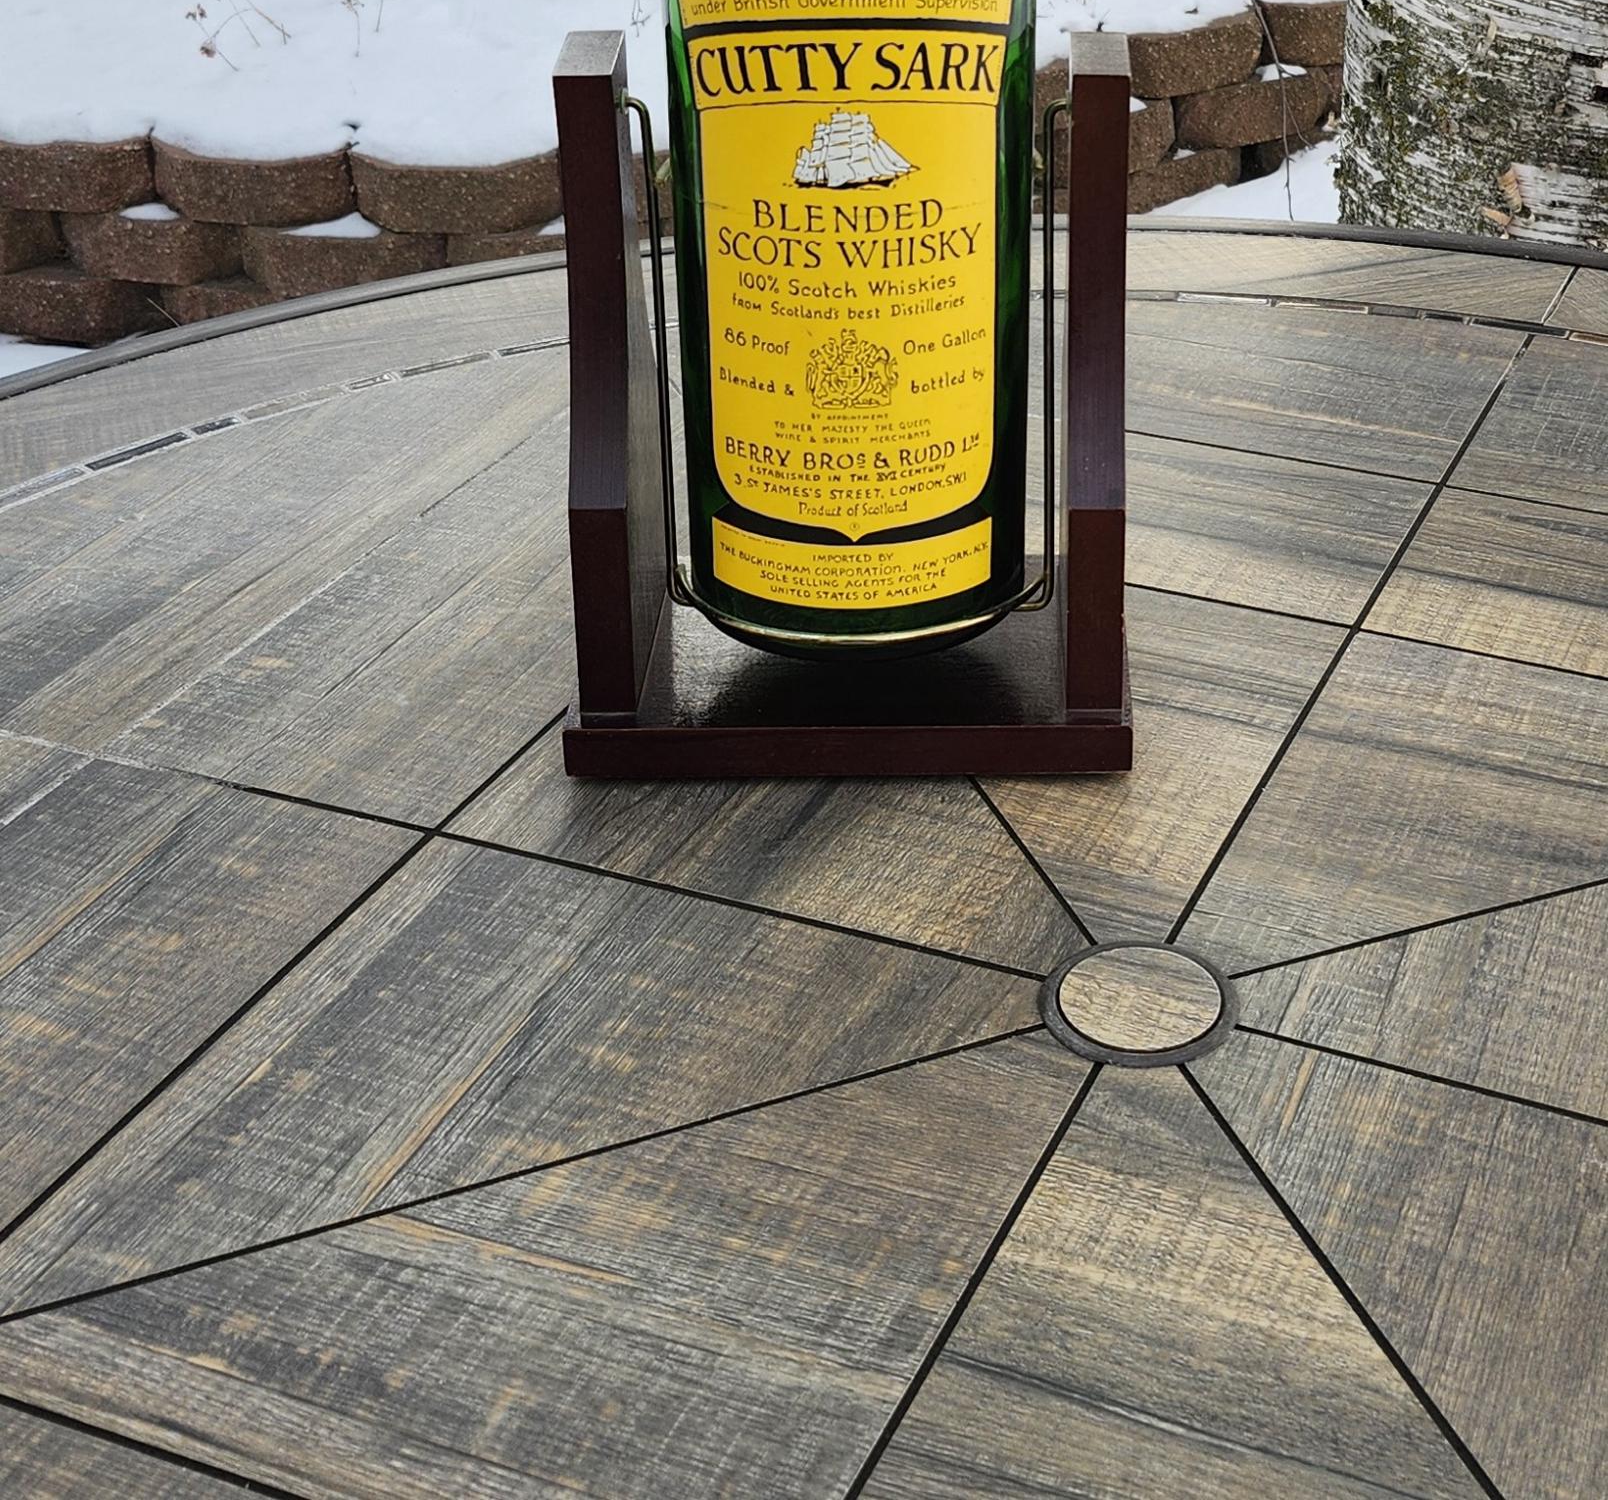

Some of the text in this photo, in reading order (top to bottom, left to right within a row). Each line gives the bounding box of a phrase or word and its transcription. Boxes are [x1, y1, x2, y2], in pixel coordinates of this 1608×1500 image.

[695, 41, 999, 97] CUTTY SARK
[752, 198, 944, 233] BLENDED
[718, 222, 982, 268] SCOTS WHISKY
[738, 271, 957, 299] 100% Scotch Whiskies
[771, 300, 840, 320] Scotland's
[847, 304, 880, 319] best
[891, 295, 965, 317] Distilleries
[724, 327, 986, 356] 86 Proof One Gallon
[719, 366, 985, 396] Blended & bottled by
[774, 418, 931, 433] TO HER MAJESTY THE QUEEN
[775, 432, 801, 442] WINE
[823, 436, 860, 444] SPIRIT
[870, 430, 931, 443] MERCHANTS
[725, 436, 791, 468] BERRY
[873, 451, 890, 469] &
[899, 440, 955, 467] RUDD
[749, 464, 821, 482] ESTABLISHED
[828, 474, 841, 482] IN
[850, 473, 870, 483] THE
[900, 462, 946, 479] CENTURY
[763, 481, 822, 499] JAMES'S
[798, 499, 908, 517] Product of Scotland
[719, 541, 736, 557] THE
[739, 550, 811, 575] BUCKINGHAM
[912, 559, 939, 572] NEW
[812, 553, 894, 564] IMPORTED BY
[760, 567, 946, 589] SOLE SELLING AGENTS FOR THE
[770, 582, 937, 601] UNITED STATES OF AMERICA
